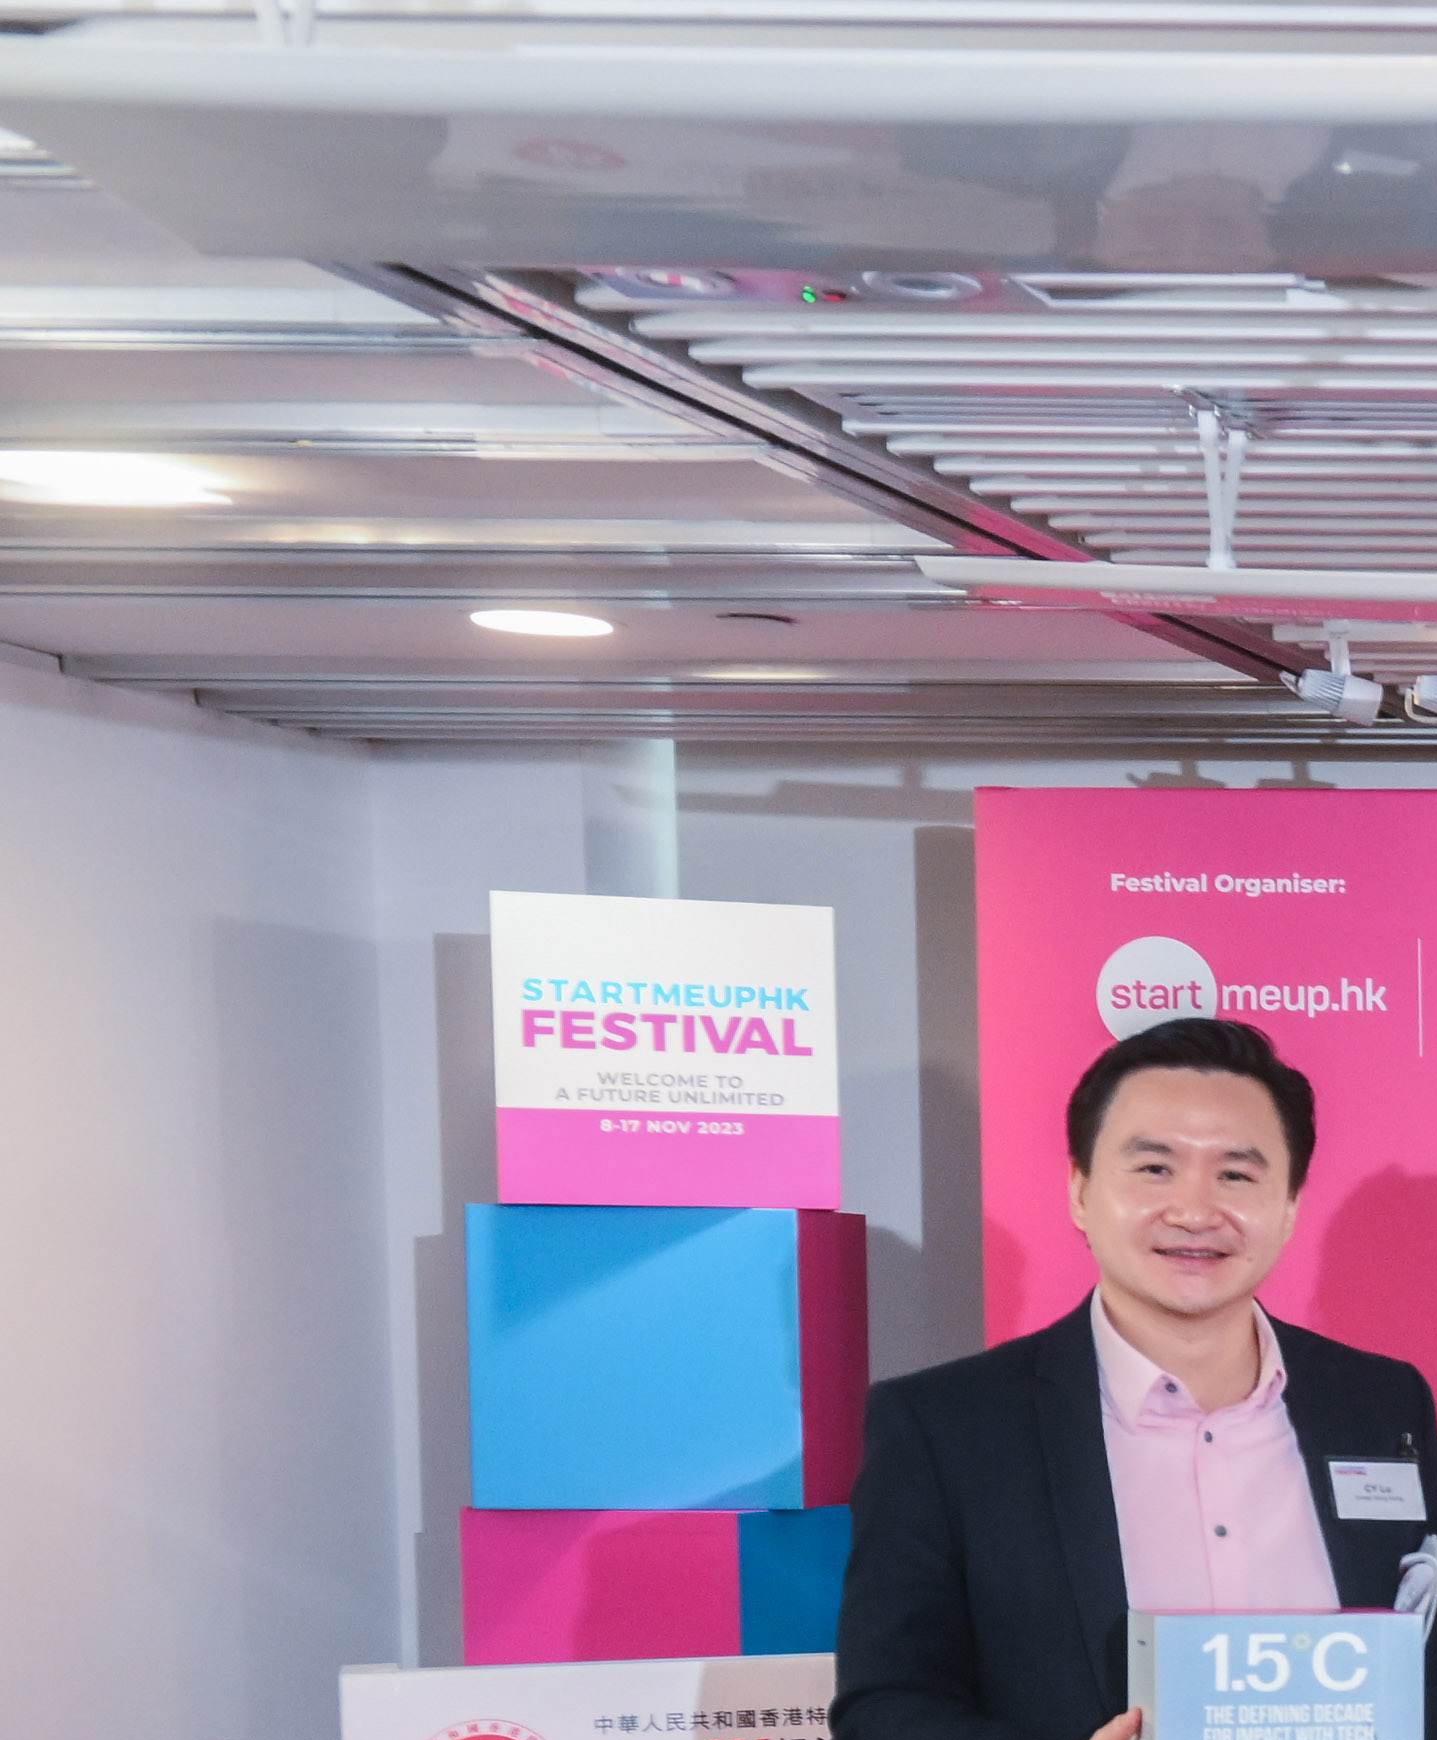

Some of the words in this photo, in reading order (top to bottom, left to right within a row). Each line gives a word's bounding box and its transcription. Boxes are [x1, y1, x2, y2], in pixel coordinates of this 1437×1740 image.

[1111, 873, 1207, 894] Festival
[1215, 874, 1346, 897] Organiser:
[523, 979, 809, 1011] STARTMEUPHK
[1110, 981, 1202, 1010] start
[522, 1009, 813, 1056] FESTIVAL
[597, 1072, 707, 1088] WELCOME
[716, 1075, 743, 1089] TO
[555, 1087, 570, 1100] A
[578, 1088, 660, 1104] FUTURE
[670, 1090, 784, 1106] UNLIMITED
[600, 1119, 640, 1133] 8-17
[647, 1120, 690, 1134] NOV
[698, 1122, 744, 1135] 2023
[1204, 1705, 1235, 1723] THE
[1239, 1704, 1310, 1723] DEFINING
[1315, 1704, 1375, 1722] DECADE
